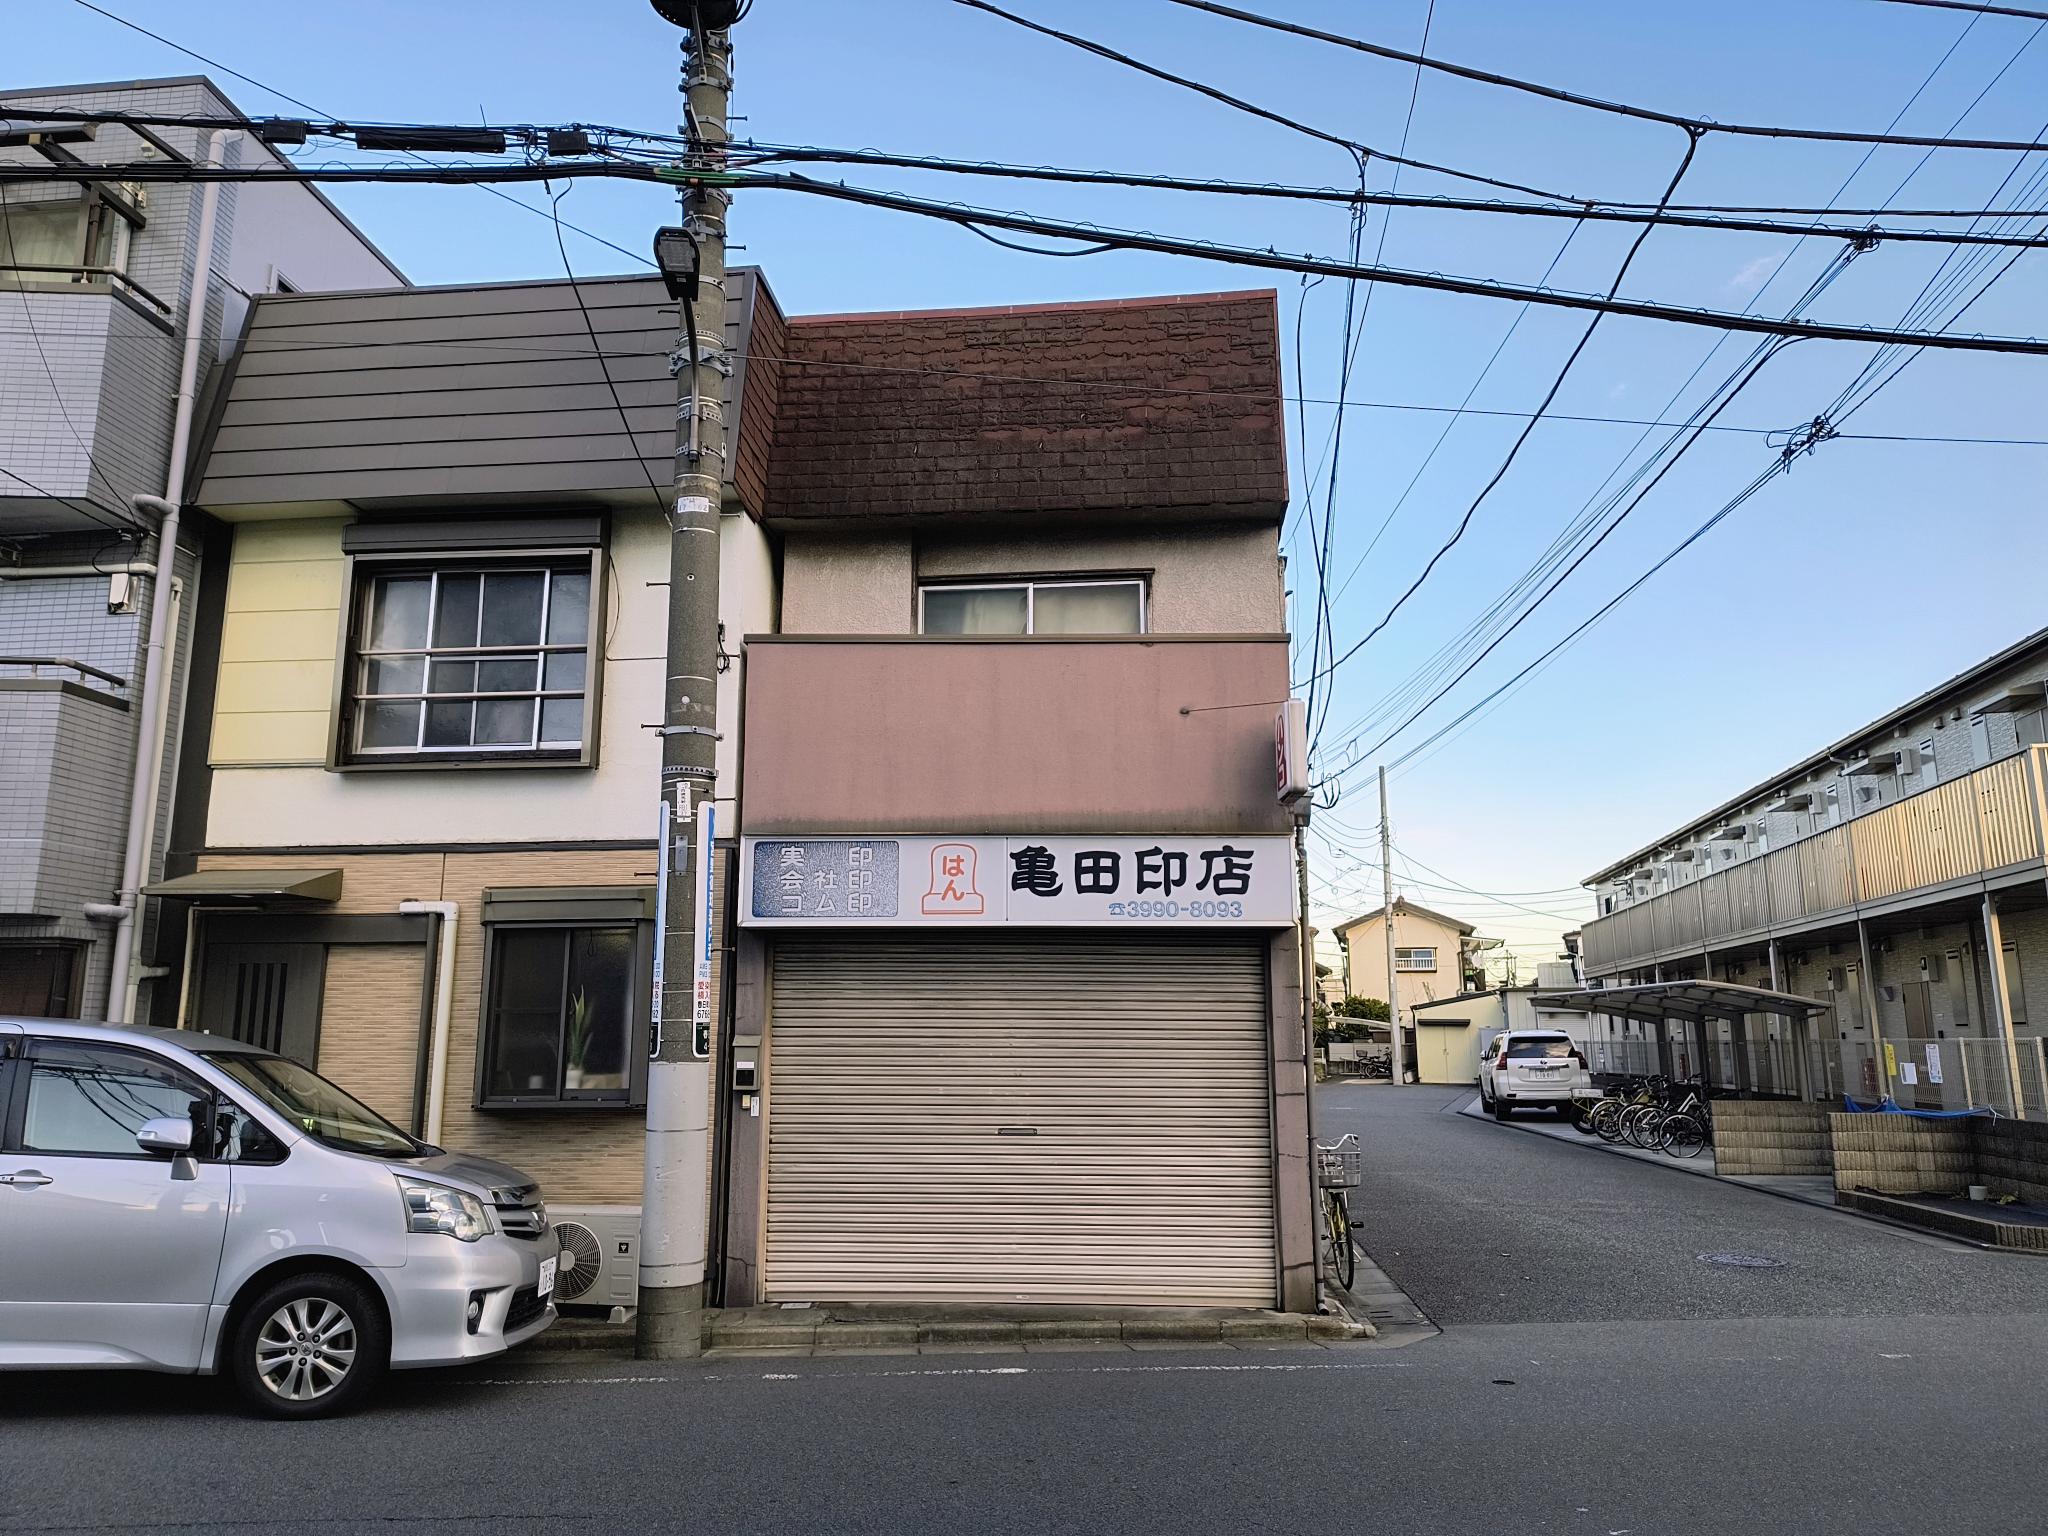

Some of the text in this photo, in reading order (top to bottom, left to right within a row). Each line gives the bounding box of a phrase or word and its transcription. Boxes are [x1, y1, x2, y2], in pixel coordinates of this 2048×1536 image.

[780, 869, 873, 890] 会社印
[941, 854, 965, 901] はん
[1009, 844, 1255, 897] 亀田印店
[780, 892, 873, 913] ゴム印
[1127, 900, 1243, 918] 3990-8093
